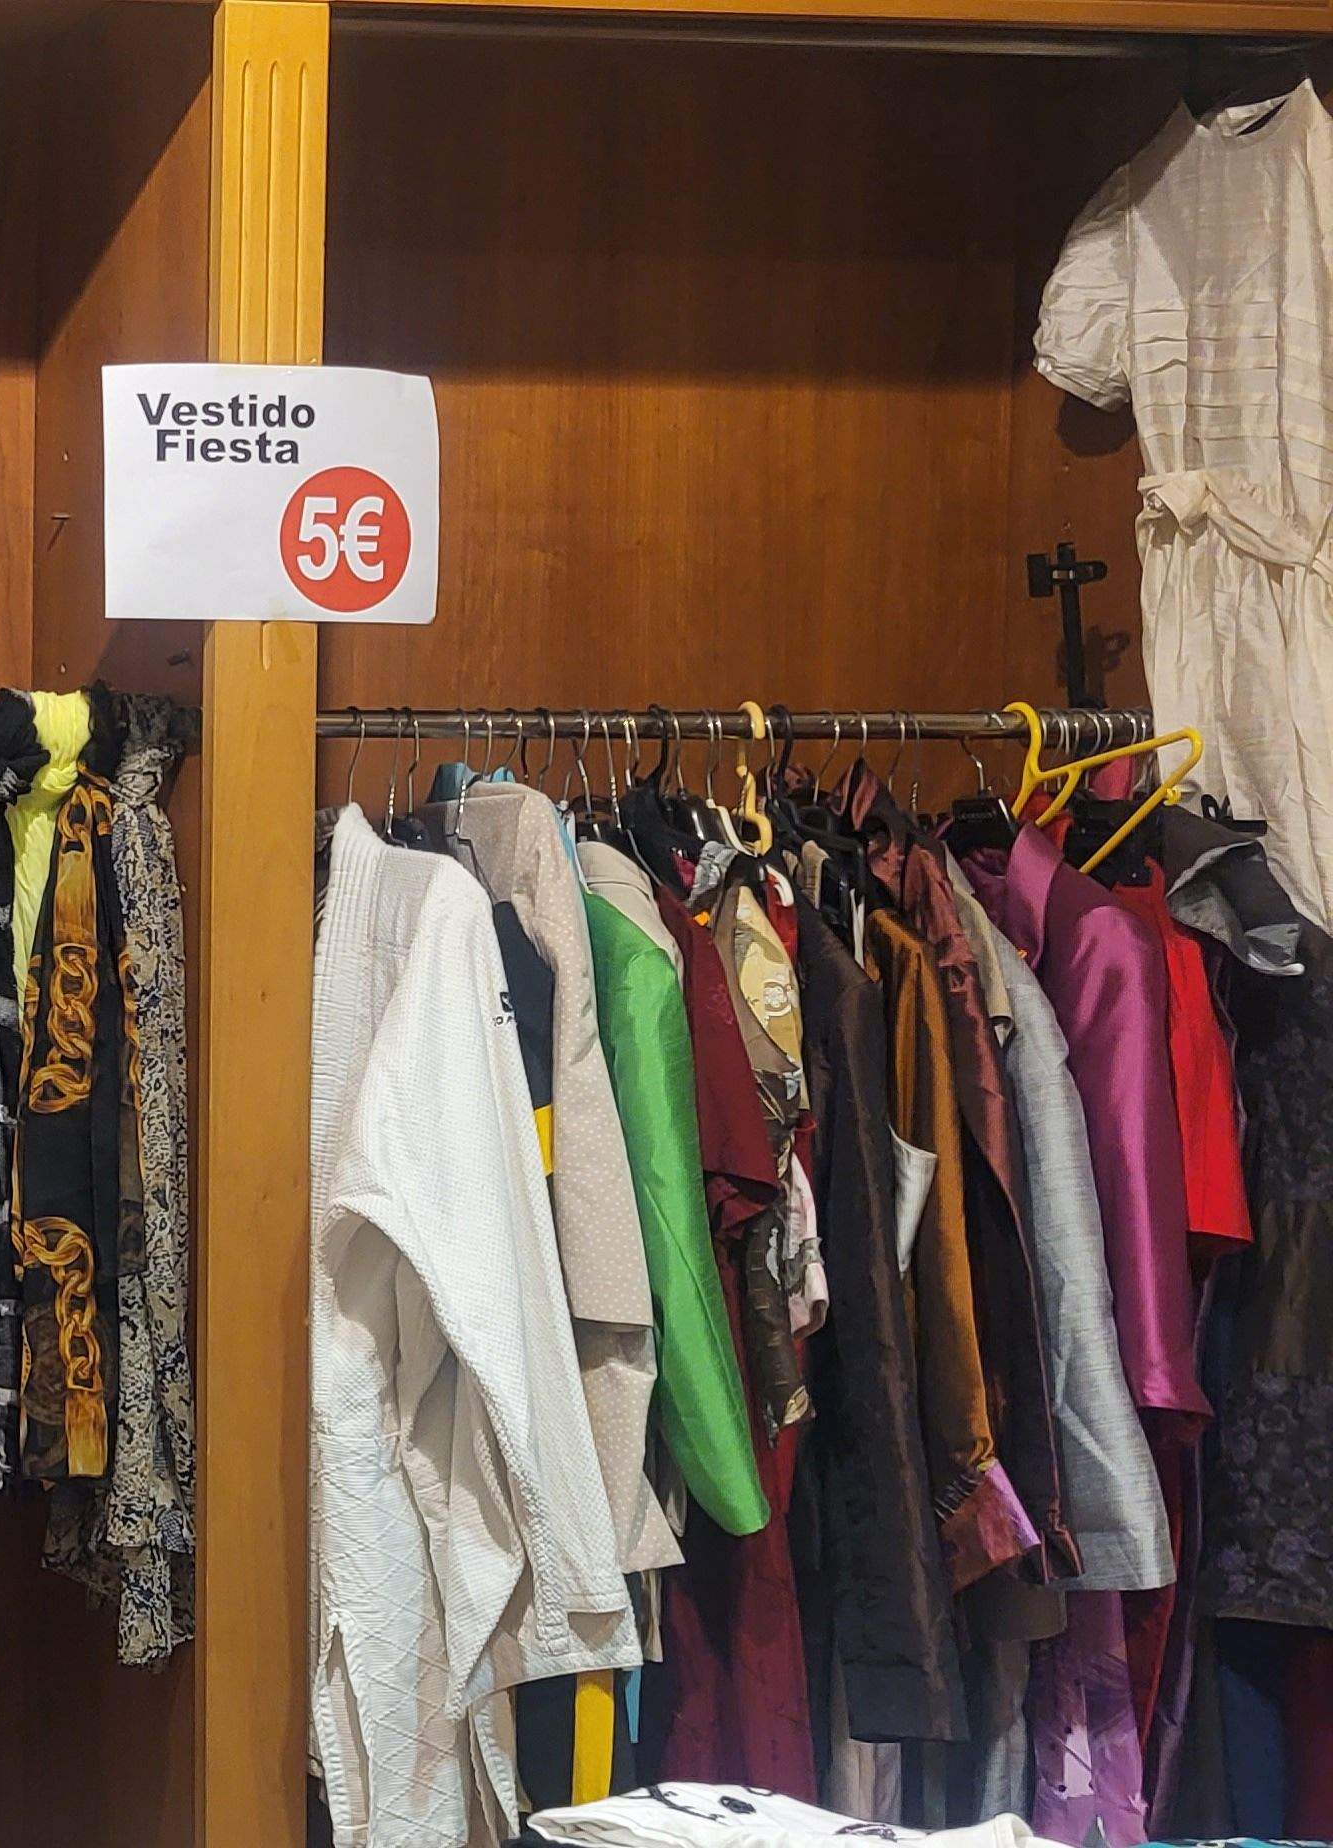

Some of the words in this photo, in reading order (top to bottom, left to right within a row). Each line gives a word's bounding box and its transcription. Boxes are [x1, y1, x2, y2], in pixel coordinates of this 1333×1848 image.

[136, 393, 316, 429] Vestido
[155, 429, 299, 464] Fiesta
[296, 495, 385, 582] 5€
